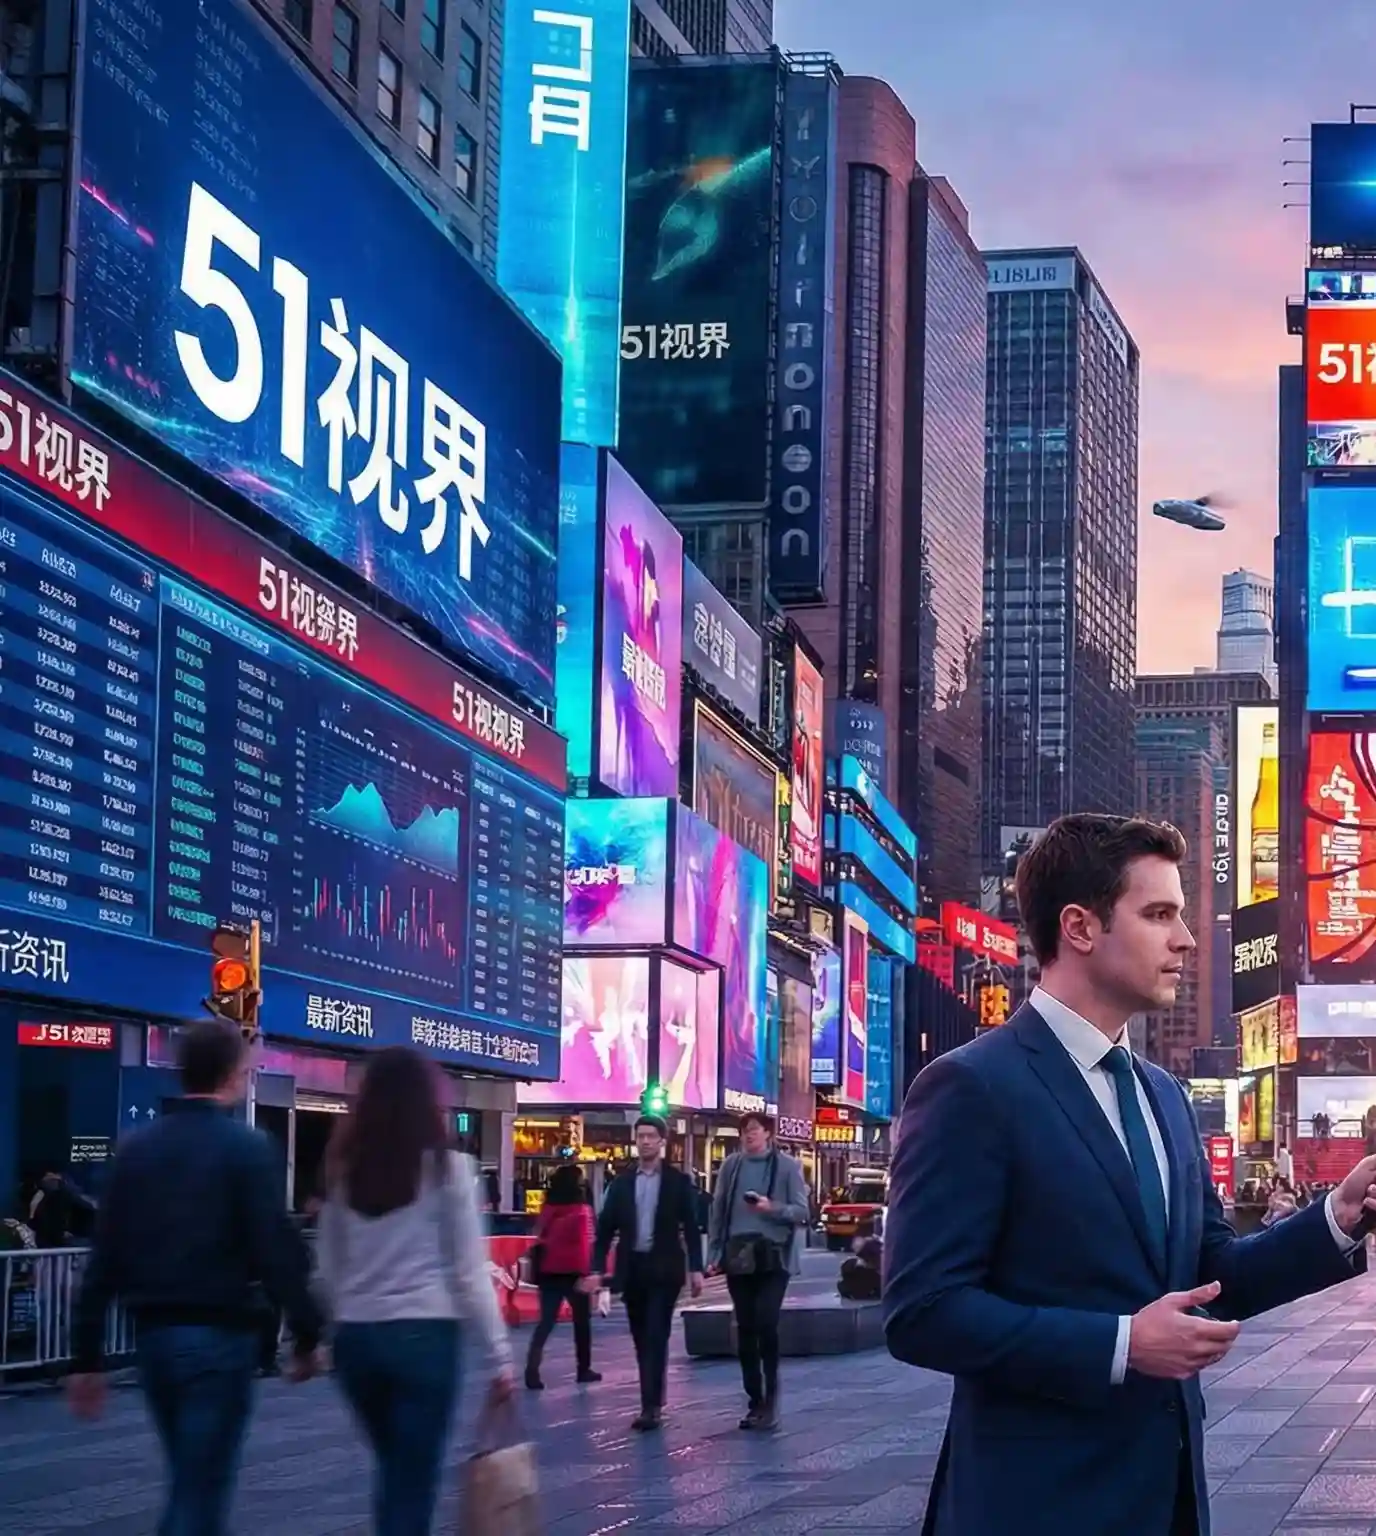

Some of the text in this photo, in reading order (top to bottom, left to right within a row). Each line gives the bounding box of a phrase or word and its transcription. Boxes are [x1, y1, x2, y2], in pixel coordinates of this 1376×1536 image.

[174, 181, 491, 582] 51视界
[620, 322, 730, 360] 51视界
[0, 388, 111, 511] 51视界
[306, 994, 374, 1038] 最新资讯
